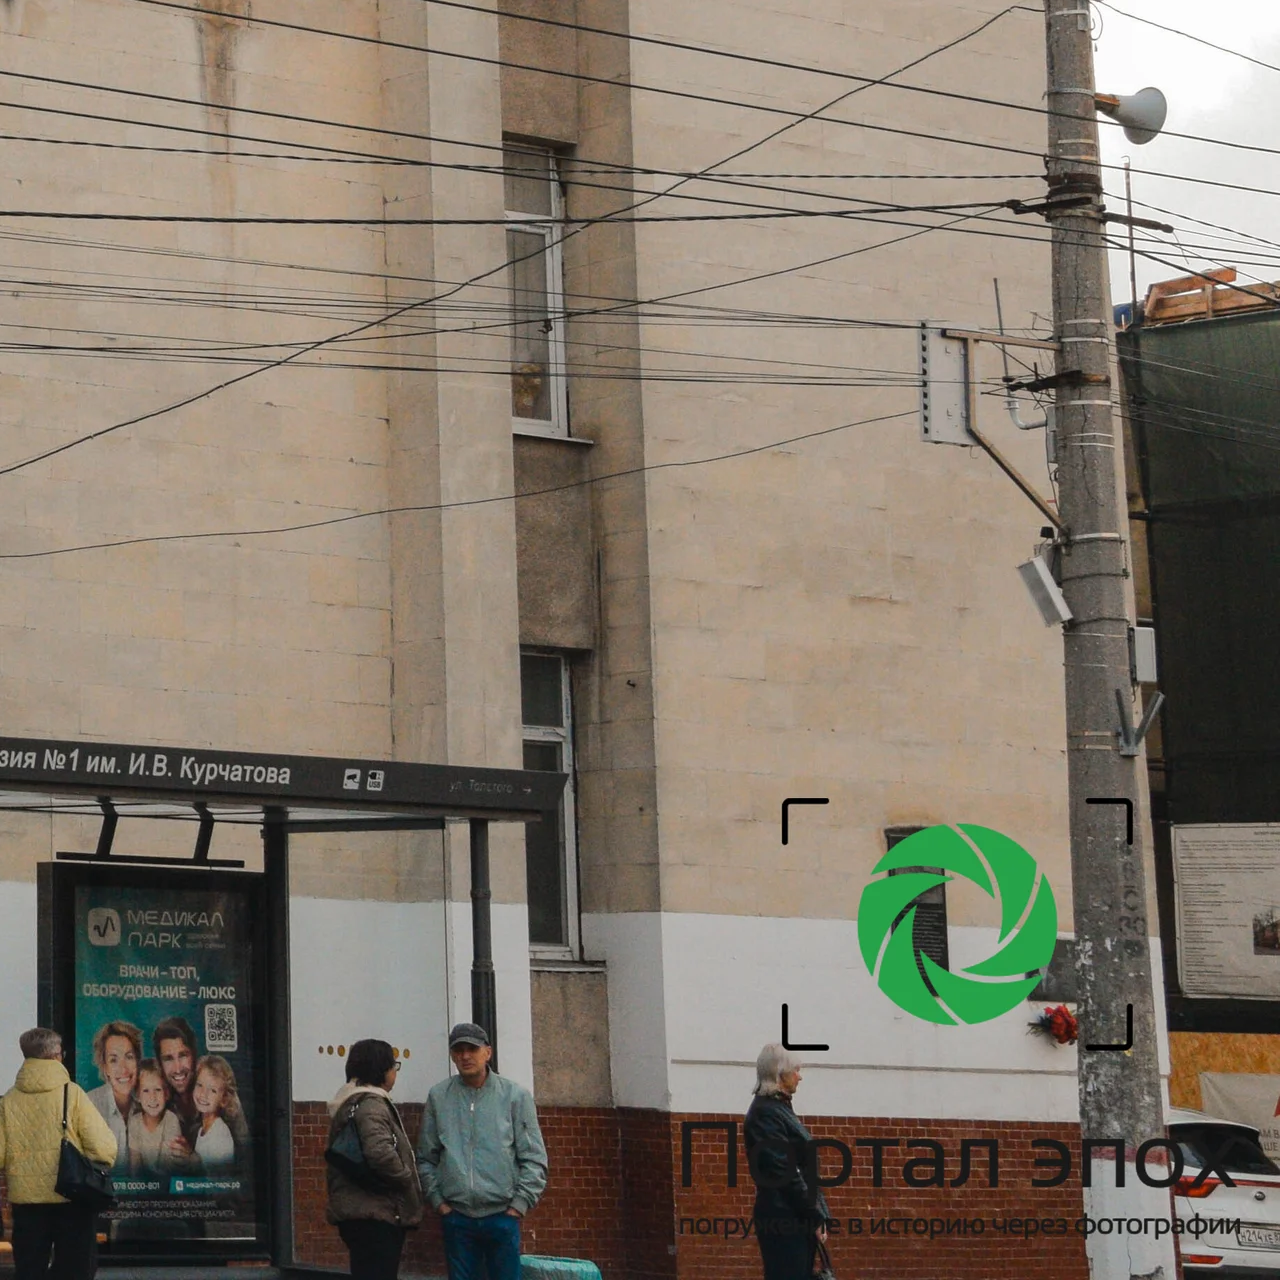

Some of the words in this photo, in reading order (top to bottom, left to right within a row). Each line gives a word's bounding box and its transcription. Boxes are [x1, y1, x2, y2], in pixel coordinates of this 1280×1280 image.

[43, 748, 79, 771] №1
[86, 753, 121, 774] им.
[129, 752, 172, 778] И.В.
[179, 756, 291, 786] Курчатова
[368, 780, 381, 789] USB
[469, 778, 514, 794] Толстого
[127, 909, 224, 928] МЕДИКАЛ
[128, 931, 183, 949] ПАРК
[119, 964, 159, 978] ВРАЧИ
[169, 966, 201, 982] ТОП,
[82, 983, 188, 1001] ОБОРУДОВАНИЕ
[197, 986, 236, 1000] ЛЮКС
